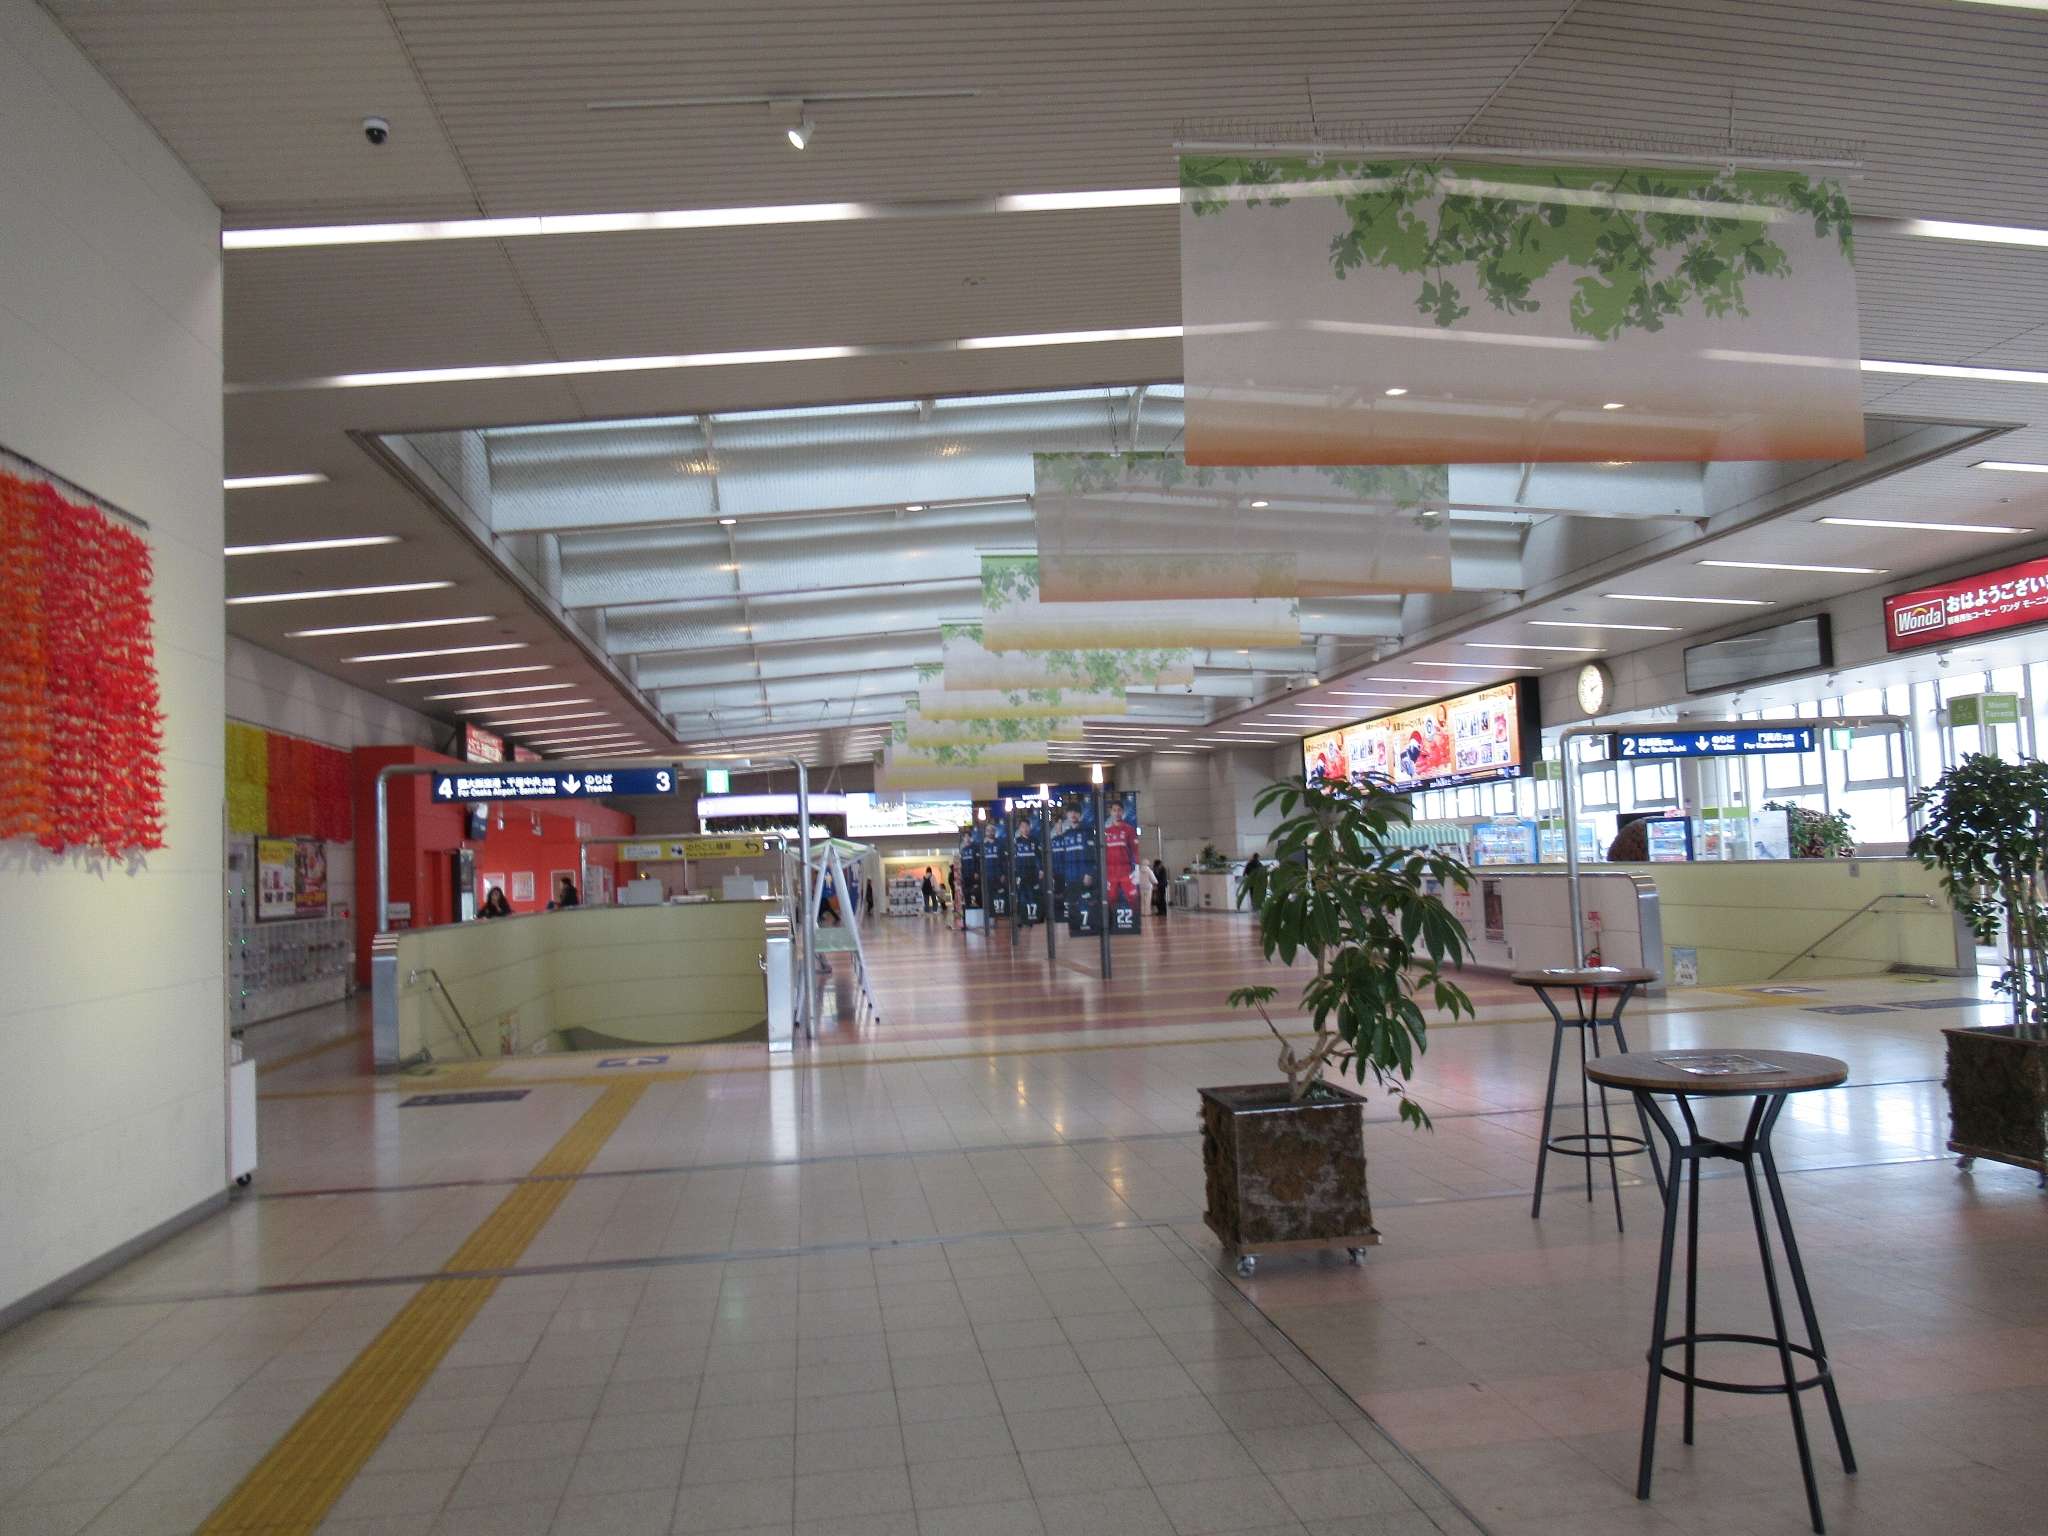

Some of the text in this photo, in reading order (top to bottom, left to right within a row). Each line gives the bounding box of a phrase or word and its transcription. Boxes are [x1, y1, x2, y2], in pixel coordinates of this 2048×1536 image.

[1899, 607, 1941, 631] Wonda
[1622, 738, 1636, 755] 2
[1800, 731, 1809, 748] 1
[438, 778, 453, 799] 4
[656, 771, 671, 792] 3
[1026, 903, 1038, 916] 17
[1080, 911, 1088, 925] 7
[1117, 908, 1133, 923] 22
